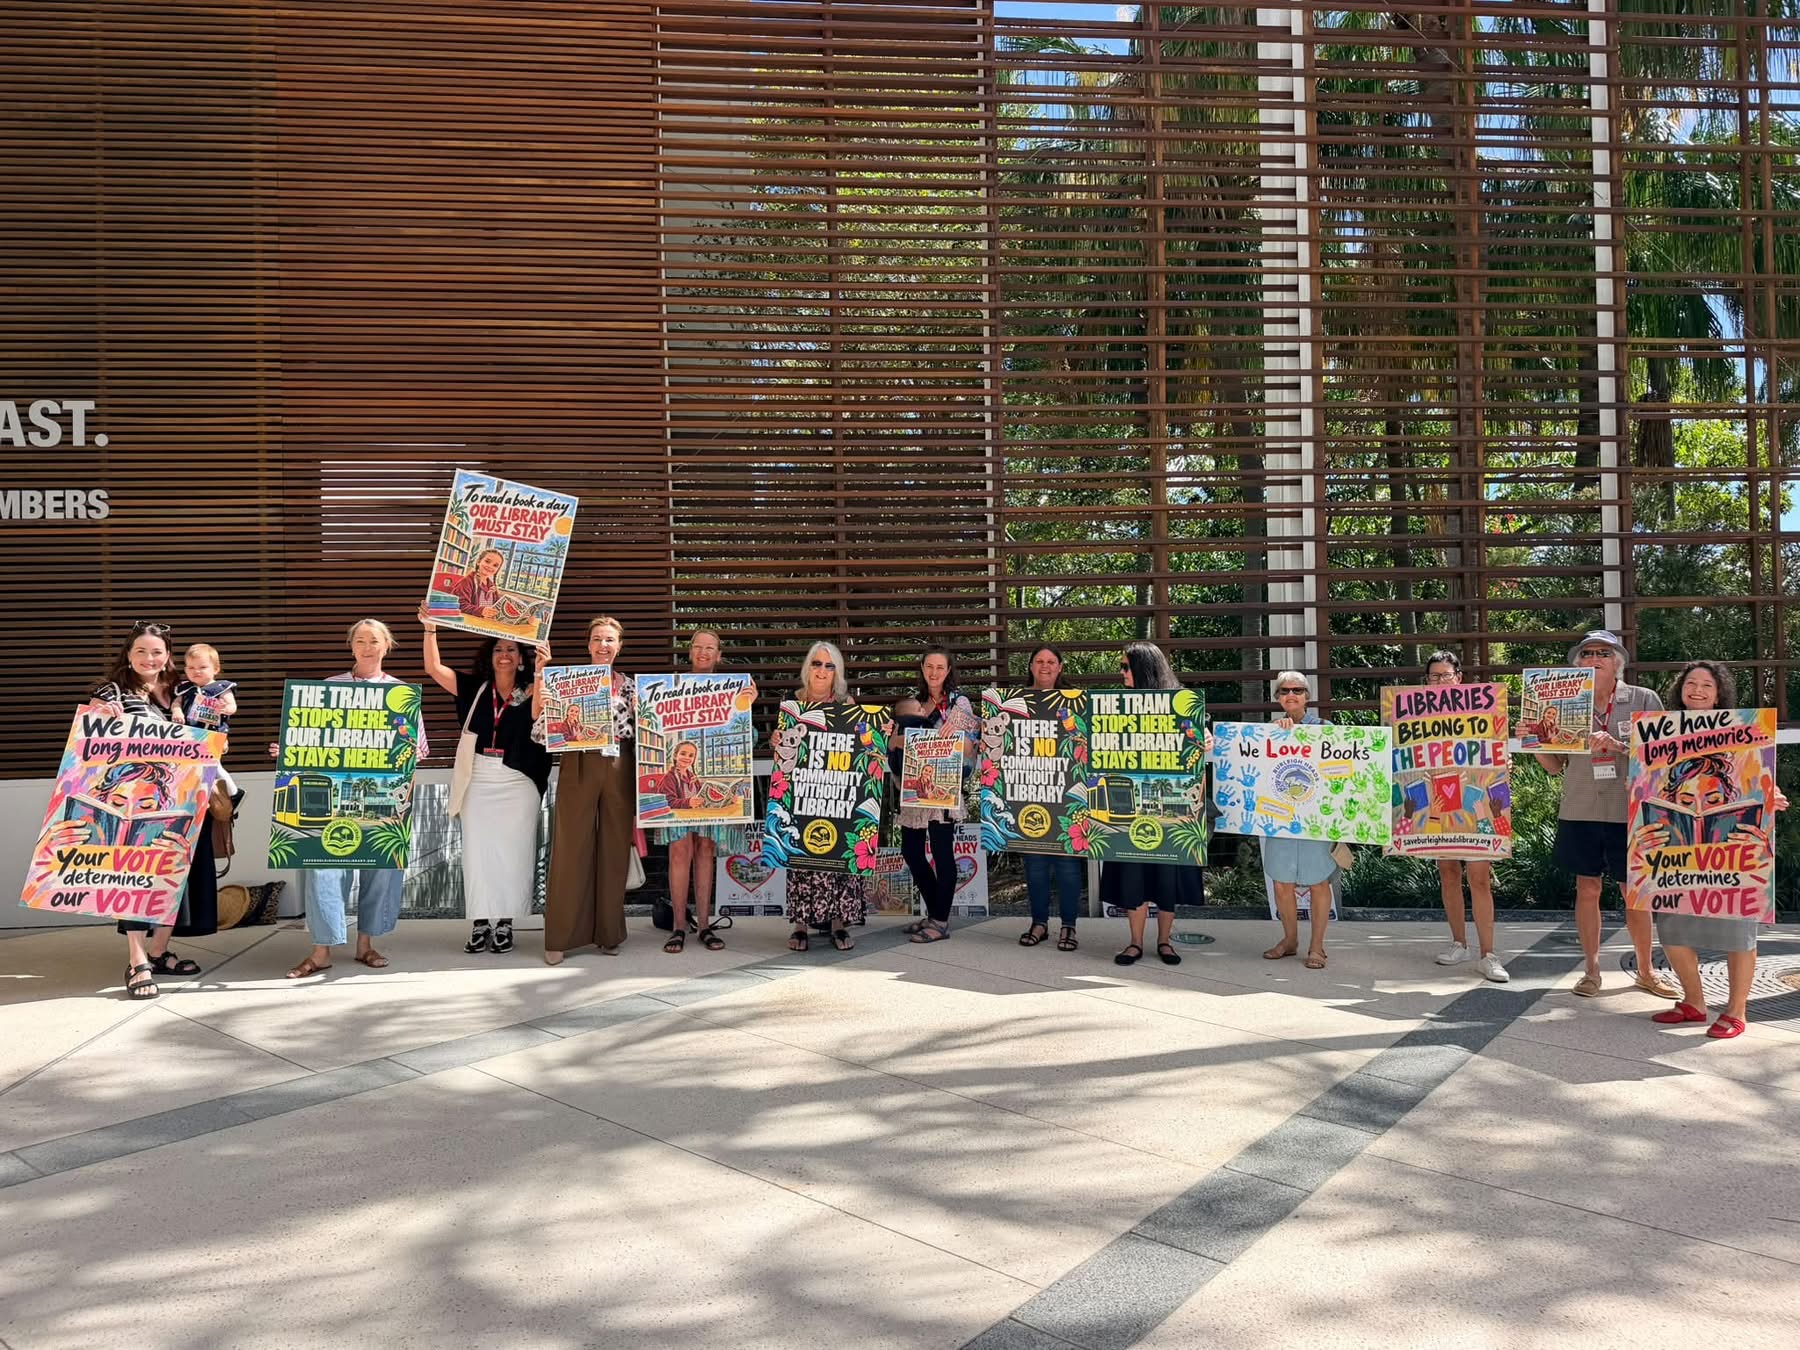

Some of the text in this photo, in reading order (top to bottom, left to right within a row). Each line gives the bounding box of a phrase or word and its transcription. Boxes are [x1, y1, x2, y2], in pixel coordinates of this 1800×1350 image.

[0, 400, 108, 447] AST.
[464, 484, 488, 502] To
[480, 491, 508, 504] read
[512, 494, 535, 507] book
[546, 498, 570, 517] day
[470, 504, 558, 526] OUR LIBRARY
[472, 518, 552, 540] MUST STAY
[550, 672, 560, 683] To
[555, 676, 600, 690] OUR LIBRARY
[1530, 674, 1540, 684] To
[1535, 678, 1583, 691] OUR LIBRARY
[291, 686, 384, 709] THE TRAM
[560, 684, 599, 696] MUST STAY
[646, 681, 664, 702] To
[662, 683, 686, 700] read
[685, 687, 691, 696] a
[692, 680, 713, 695] book
[723, 678, 744, 695] day
[1538, 688, 1580, 698] MUST STAY
[656, 691, 736, 714] OUR LIBRARY
[1091, 694, 1170, 714] THE TRAM
[1396, 685, 1495, 718] LIBRARIES
[83, 715, 184, 738] We have
[288, 708, 392, 730] STOPS HERE.
[662, 707, 732, 727] MUST STAY
[1092, 715, 1180, 733] STOPS HERE.
[1637, 716, 1675, 742] We
[1680, 710, 1732, 735] have
[286, 728, 396, 748] OUR LIBRARY
[1012, 719, 1058, 738] THERE
[1398, 716, 1488, 744] BELONG TO
[808, 732, 855, 752] THERE
[929, 740, 954, 749] LIBRARY
[1015, 738, 1056, 757] IS NO
[1091, 733, 1185, 751] OUR LIBRARY
[1239, 739, 1370, 760] We Love Books
[1682, 726, 1768, 753] memories...
[126, 741, 214, 759] memories...
[284, 747, 392, 768] STAYS HERE.
[808, 750, 850, 770] IS NO
[1428, 740, 1505, 767] PEOPLE
[1000, 756, 1069, 772] COMMUNITY
[1092, 751, 1184, 770] STAYS HERE.
[792, 768, 864, 786] COMMUNITY
[1004, 770, 1065, 786] WITHOUT A
[793, 782, 856, 800] WITHOUT A
[1006, 784, 1065, 803] LIBRARY
[794, 798, 856, 819] LIBRARY
[1404, 836, 1490, 846] saveburleighheadslibrary.org
[112, 848, 177, 876] VOTE
[1694, 844, 1757, 872] VOTE
[63, 870, 154, 888] determines
[1658, 871, 1740, 888] determines
[50, 888, 167, 916] our VOTE
[1652, 888, 1760, 915] our VOTE
